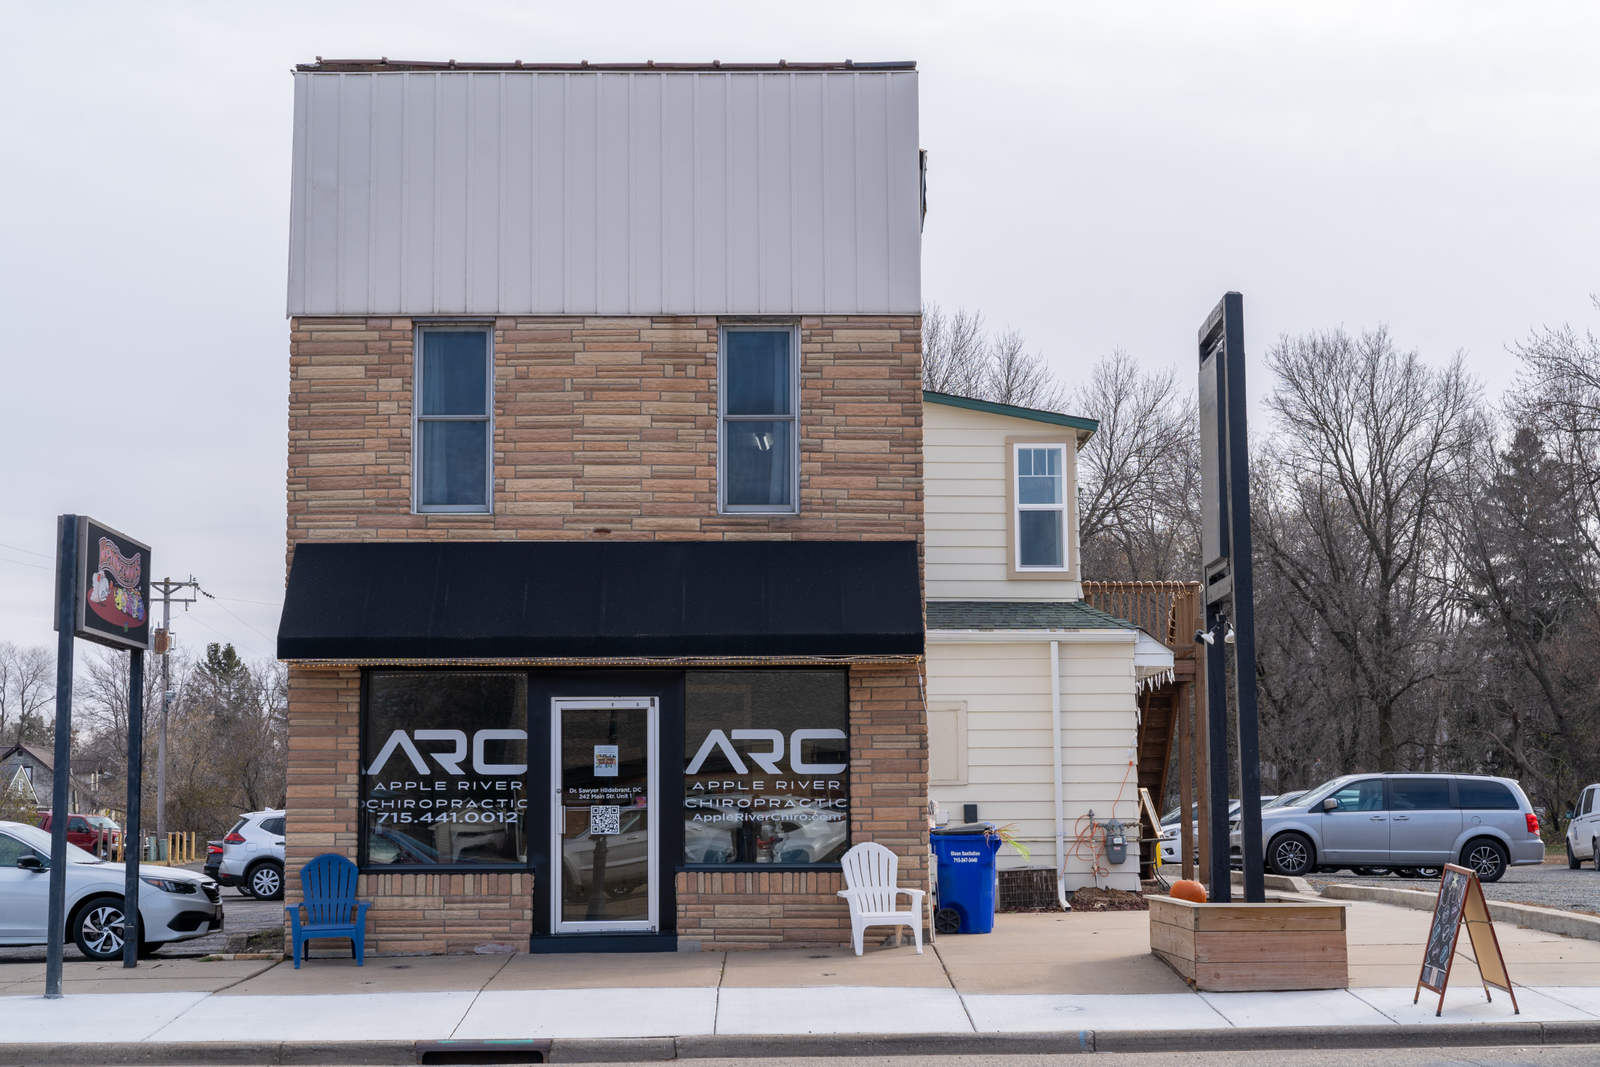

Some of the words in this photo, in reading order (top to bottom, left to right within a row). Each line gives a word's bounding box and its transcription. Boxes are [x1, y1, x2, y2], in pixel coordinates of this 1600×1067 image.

[367, 729, 528, 775] ARC
[685, 729, 847, 775] ARC
[374, 781, 447, 791] APPLE
[458, 781, 523, 791] RIVER
[692, 780, 765, 790] APPLE
[775, 780, 841, 790] RIVER
[366, 799, 528, 809] CHIROPRACTIC
[684, 798, 847, 808] CHIROPRACTIC
[377, 812, 519, 823] 715.441.0012
[692, 812, 841, 823] AppleRiverChiro.com
